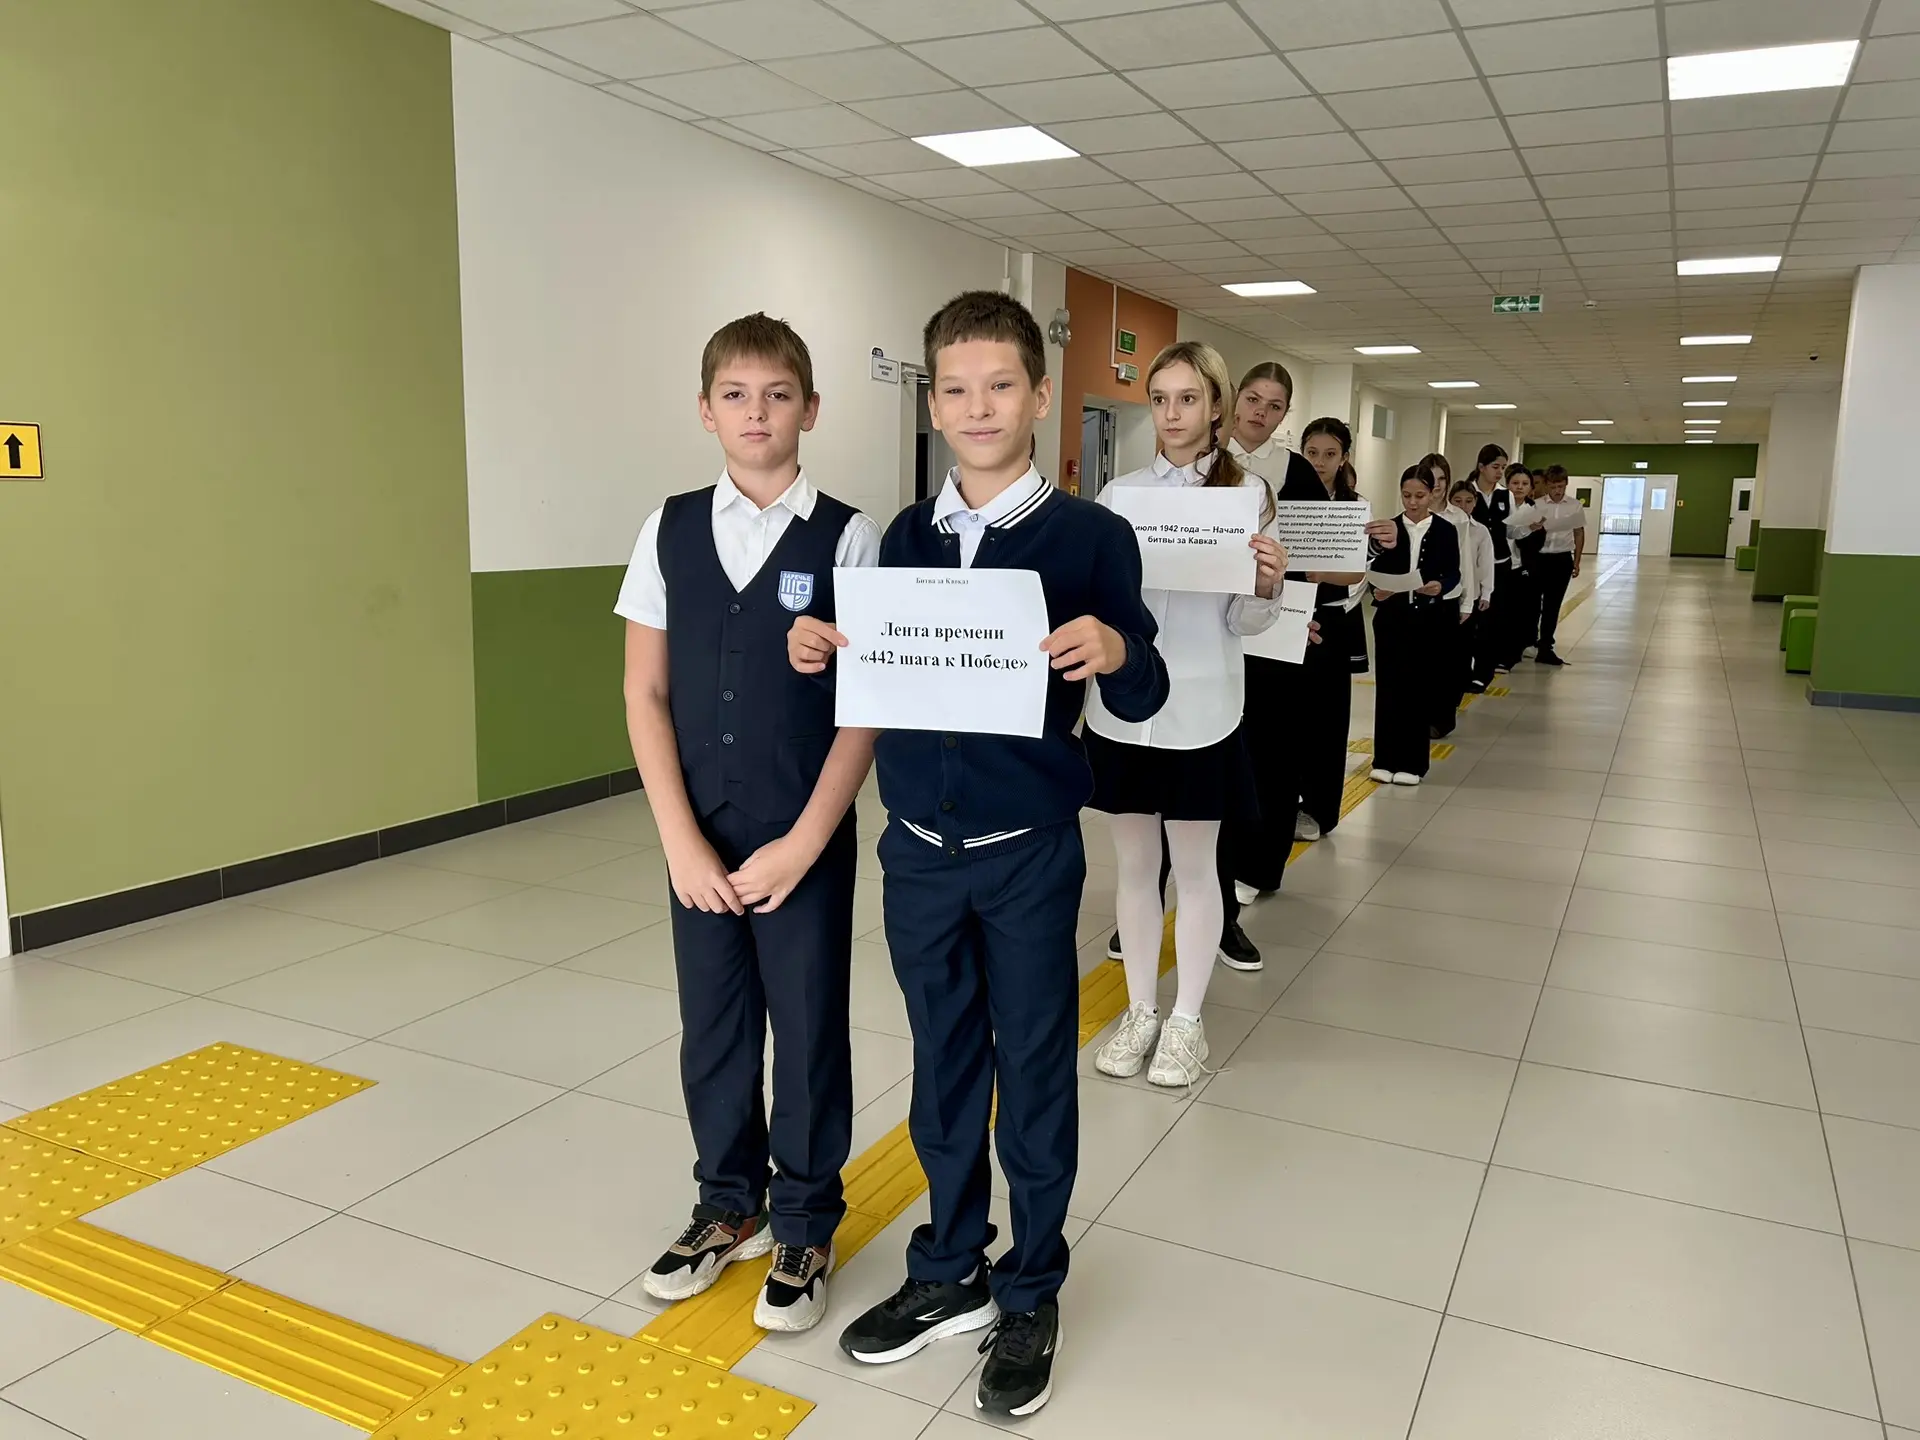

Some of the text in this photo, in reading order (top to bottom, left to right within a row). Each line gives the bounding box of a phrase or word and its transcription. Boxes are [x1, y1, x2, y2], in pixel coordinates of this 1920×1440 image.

[1159, 524, 1179, 533] 1942
[1180, 526, 1200, 534] года
[1212, 526, 1245, 535] Начало
[1147, 535, 1218, 545] битвы за Кавказ
[945, 577, 969, 585] Кавказ
[881, 622, 1004, 642] Лента времени
[860, 650, 1029, 670] «442 шага к Победе»
